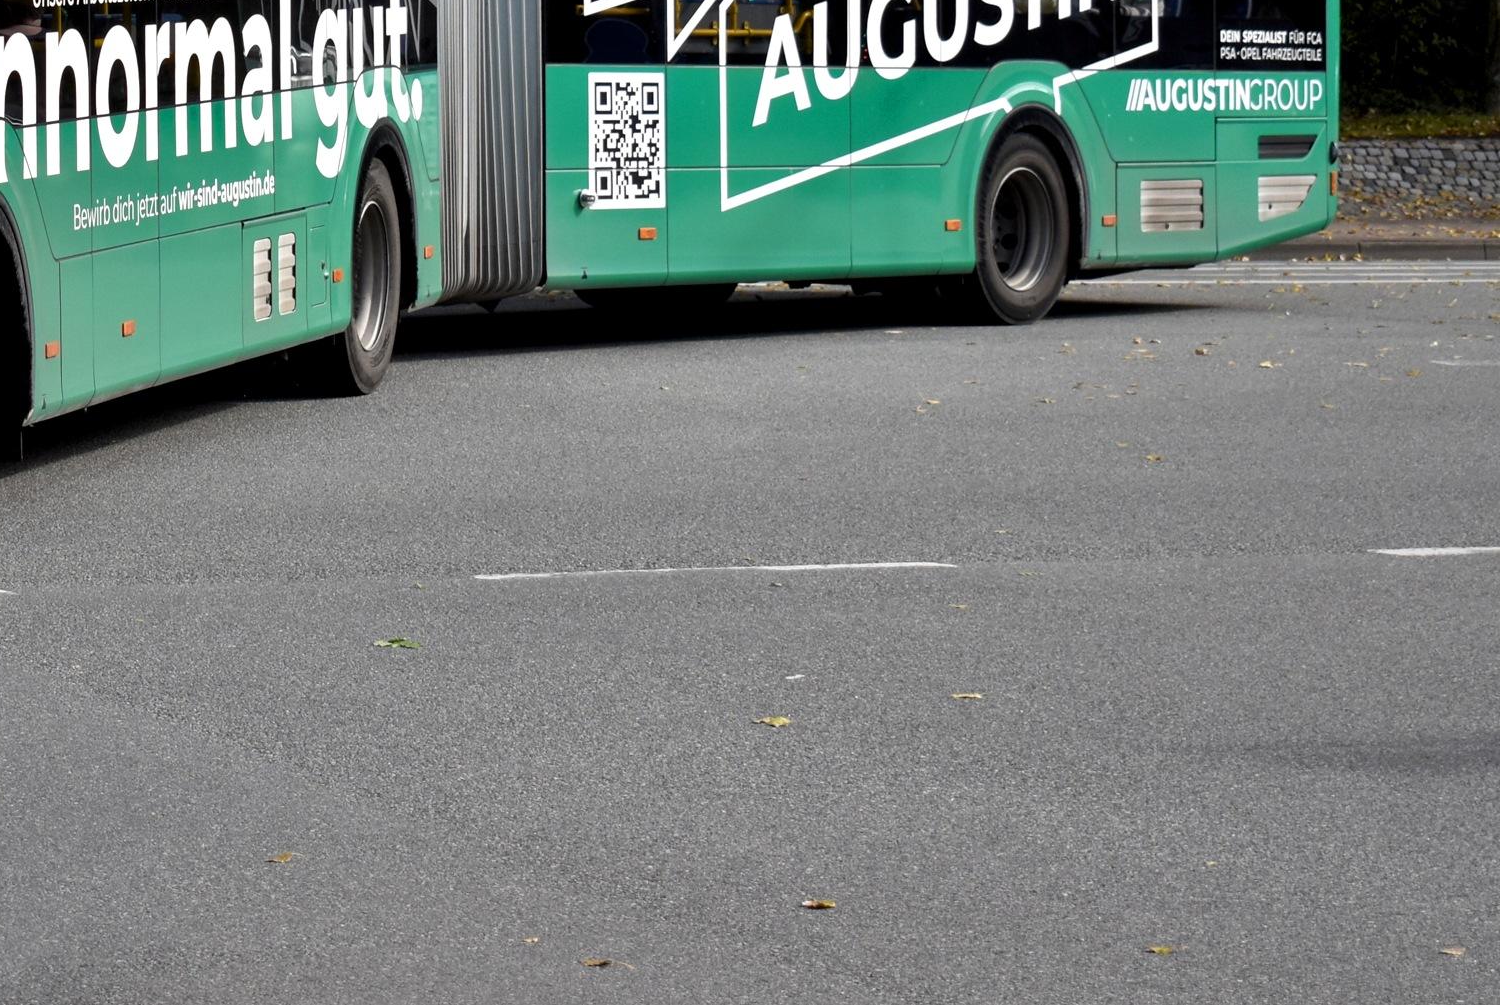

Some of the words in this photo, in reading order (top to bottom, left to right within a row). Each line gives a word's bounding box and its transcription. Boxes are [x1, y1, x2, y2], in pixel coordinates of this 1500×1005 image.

[1220, 29, 1241, 43] DEIN
[1242, 29, 1287, 44] SPEZIALIST
[1288, 30, 1305, 44] FÜR
[1306, 32, 1323, 45] FCA
[1220, 47, 1236, 60] PSA
[1240, 47, 1261, 60] OPEL
[1261, 47, 1323, 62] FAHRZEUGTEILE
[73, 198, 111, 231] Bewirb
[112, 194, 135, 223] dich
[135, 192, 159, 226] jetzt
[160, 186, 178, 215] auf
[178, 169, 276, 211] wir-sind-augustin.de
